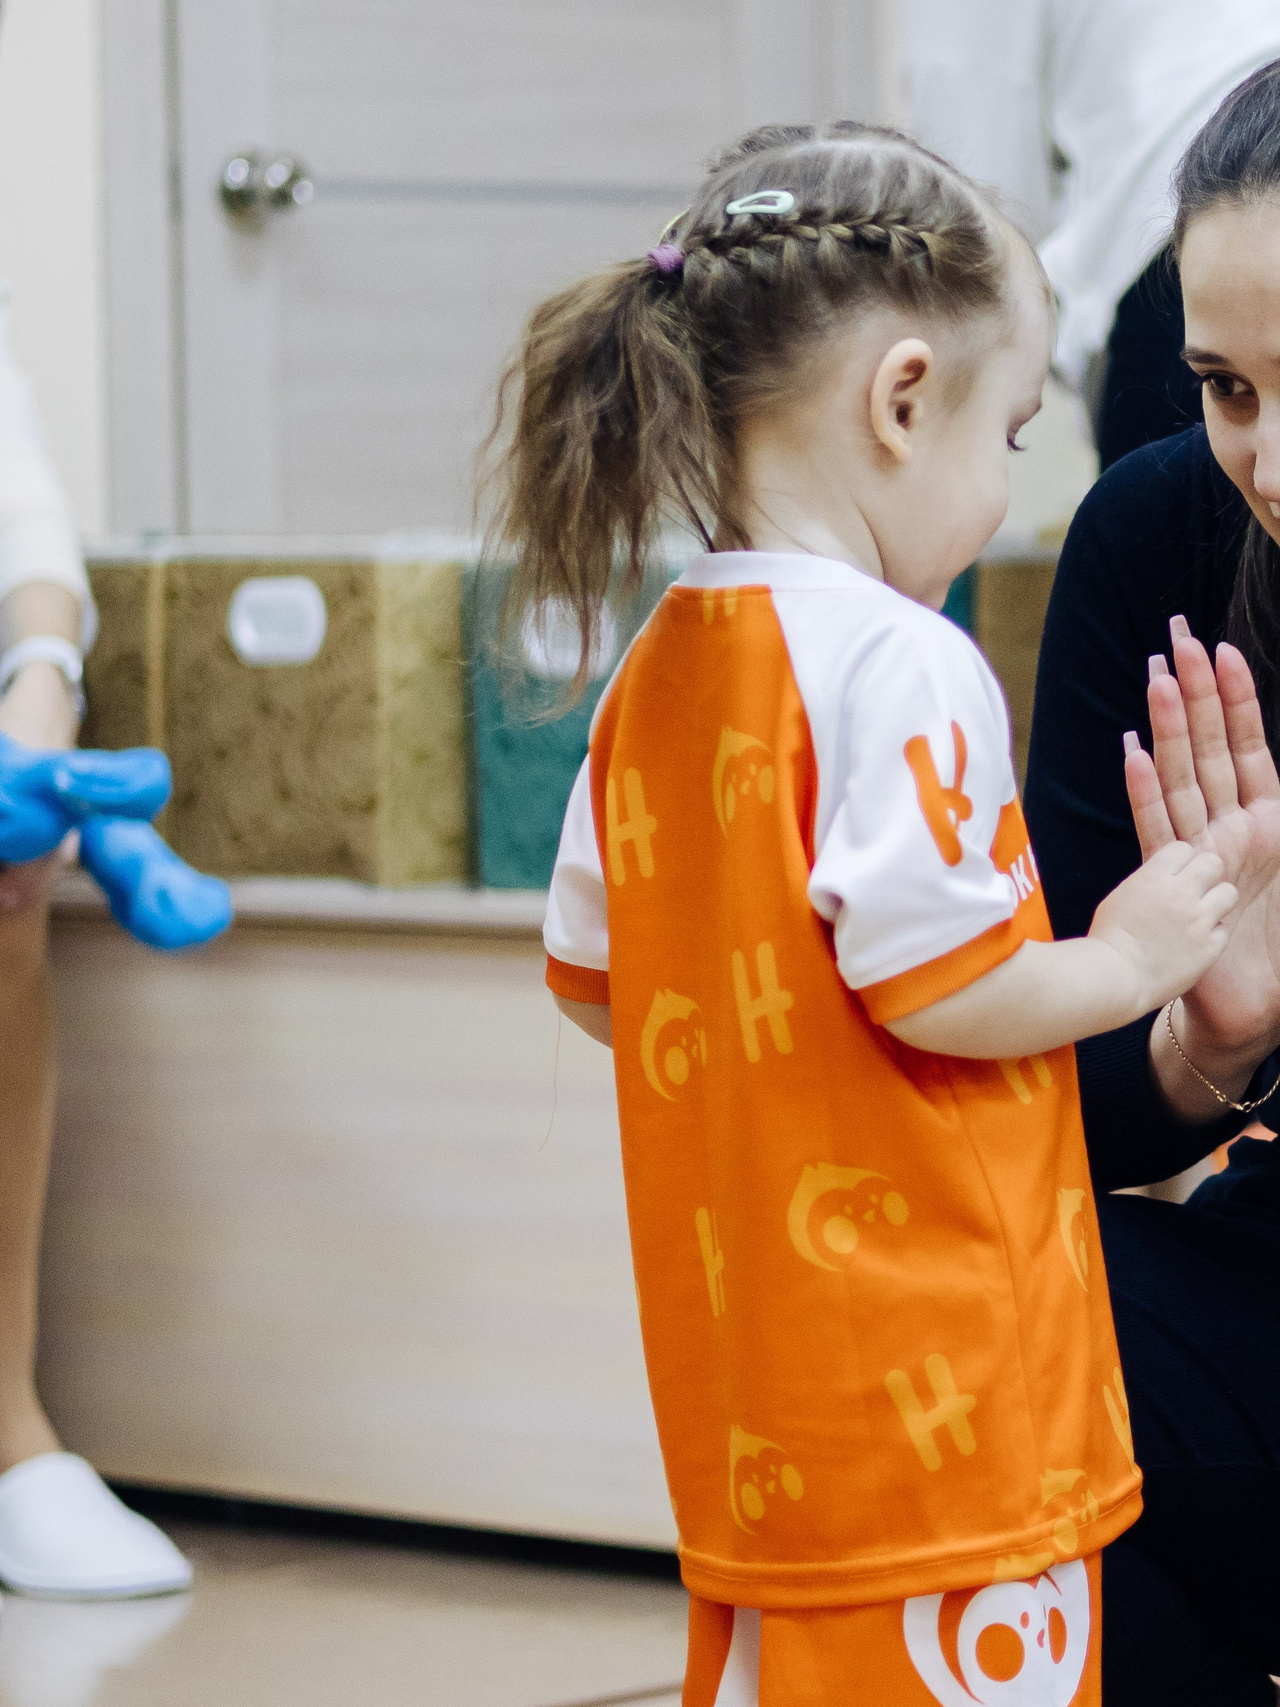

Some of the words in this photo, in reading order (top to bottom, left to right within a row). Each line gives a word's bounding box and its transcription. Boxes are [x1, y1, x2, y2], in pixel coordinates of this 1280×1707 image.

[606, 767, 657, 886] H
[732, 941, 794, 1063] H
[885, 1353, 977, 1471] H
